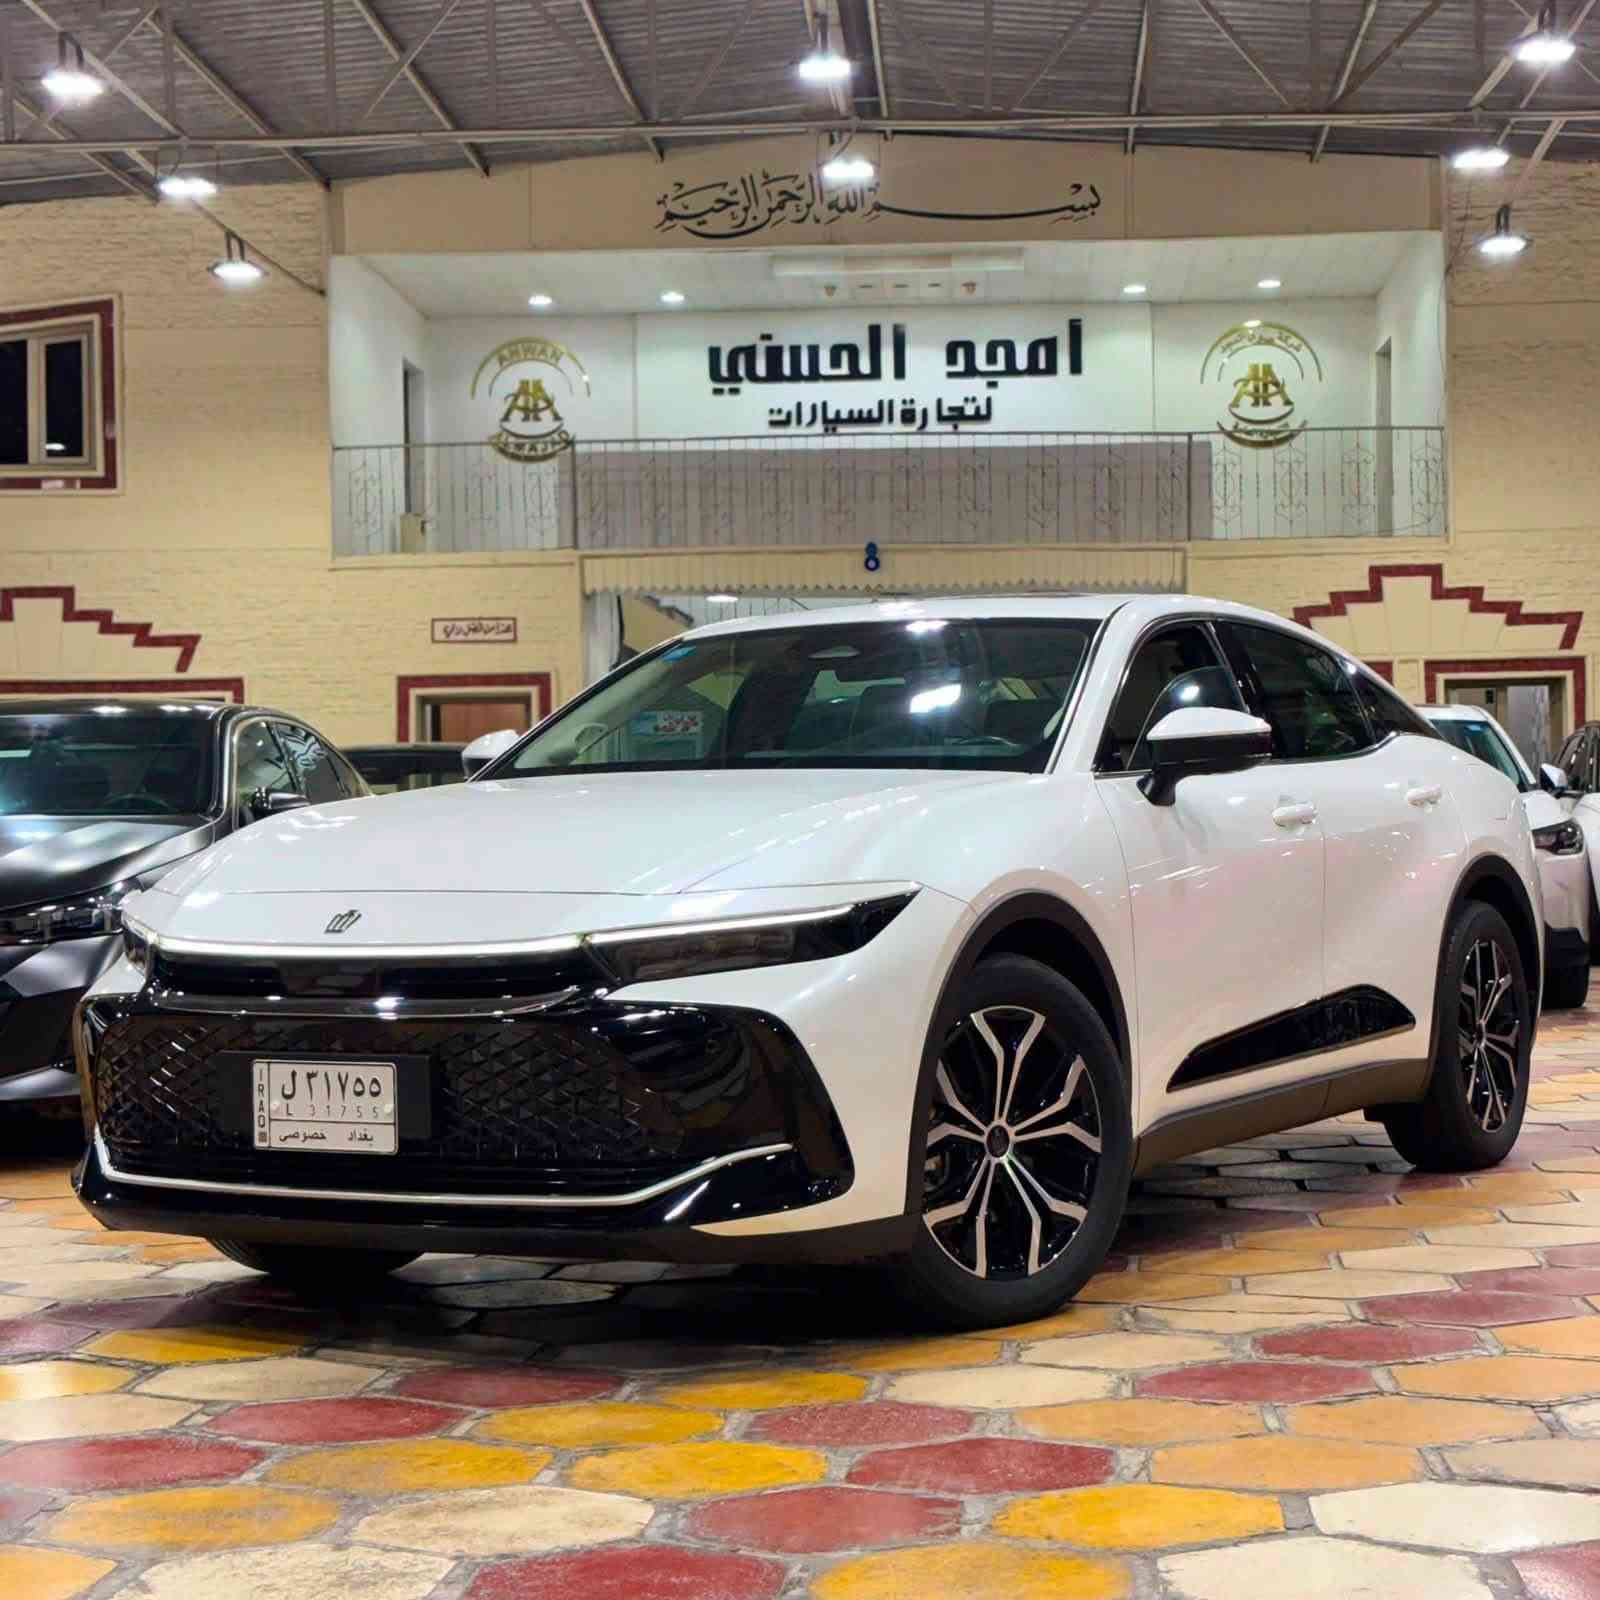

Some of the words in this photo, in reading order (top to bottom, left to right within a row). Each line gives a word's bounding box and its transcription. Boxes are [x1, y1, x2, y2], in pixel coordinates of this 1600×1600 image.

[708, 323, 906, 395] الحسني
[767, 399, 894, 433] السيارات
[900, 396, 993, 431] لتجارة
[257, 1069, 266, 1129] IRAQ
[347, 1127, 374, 1147] بغداد
